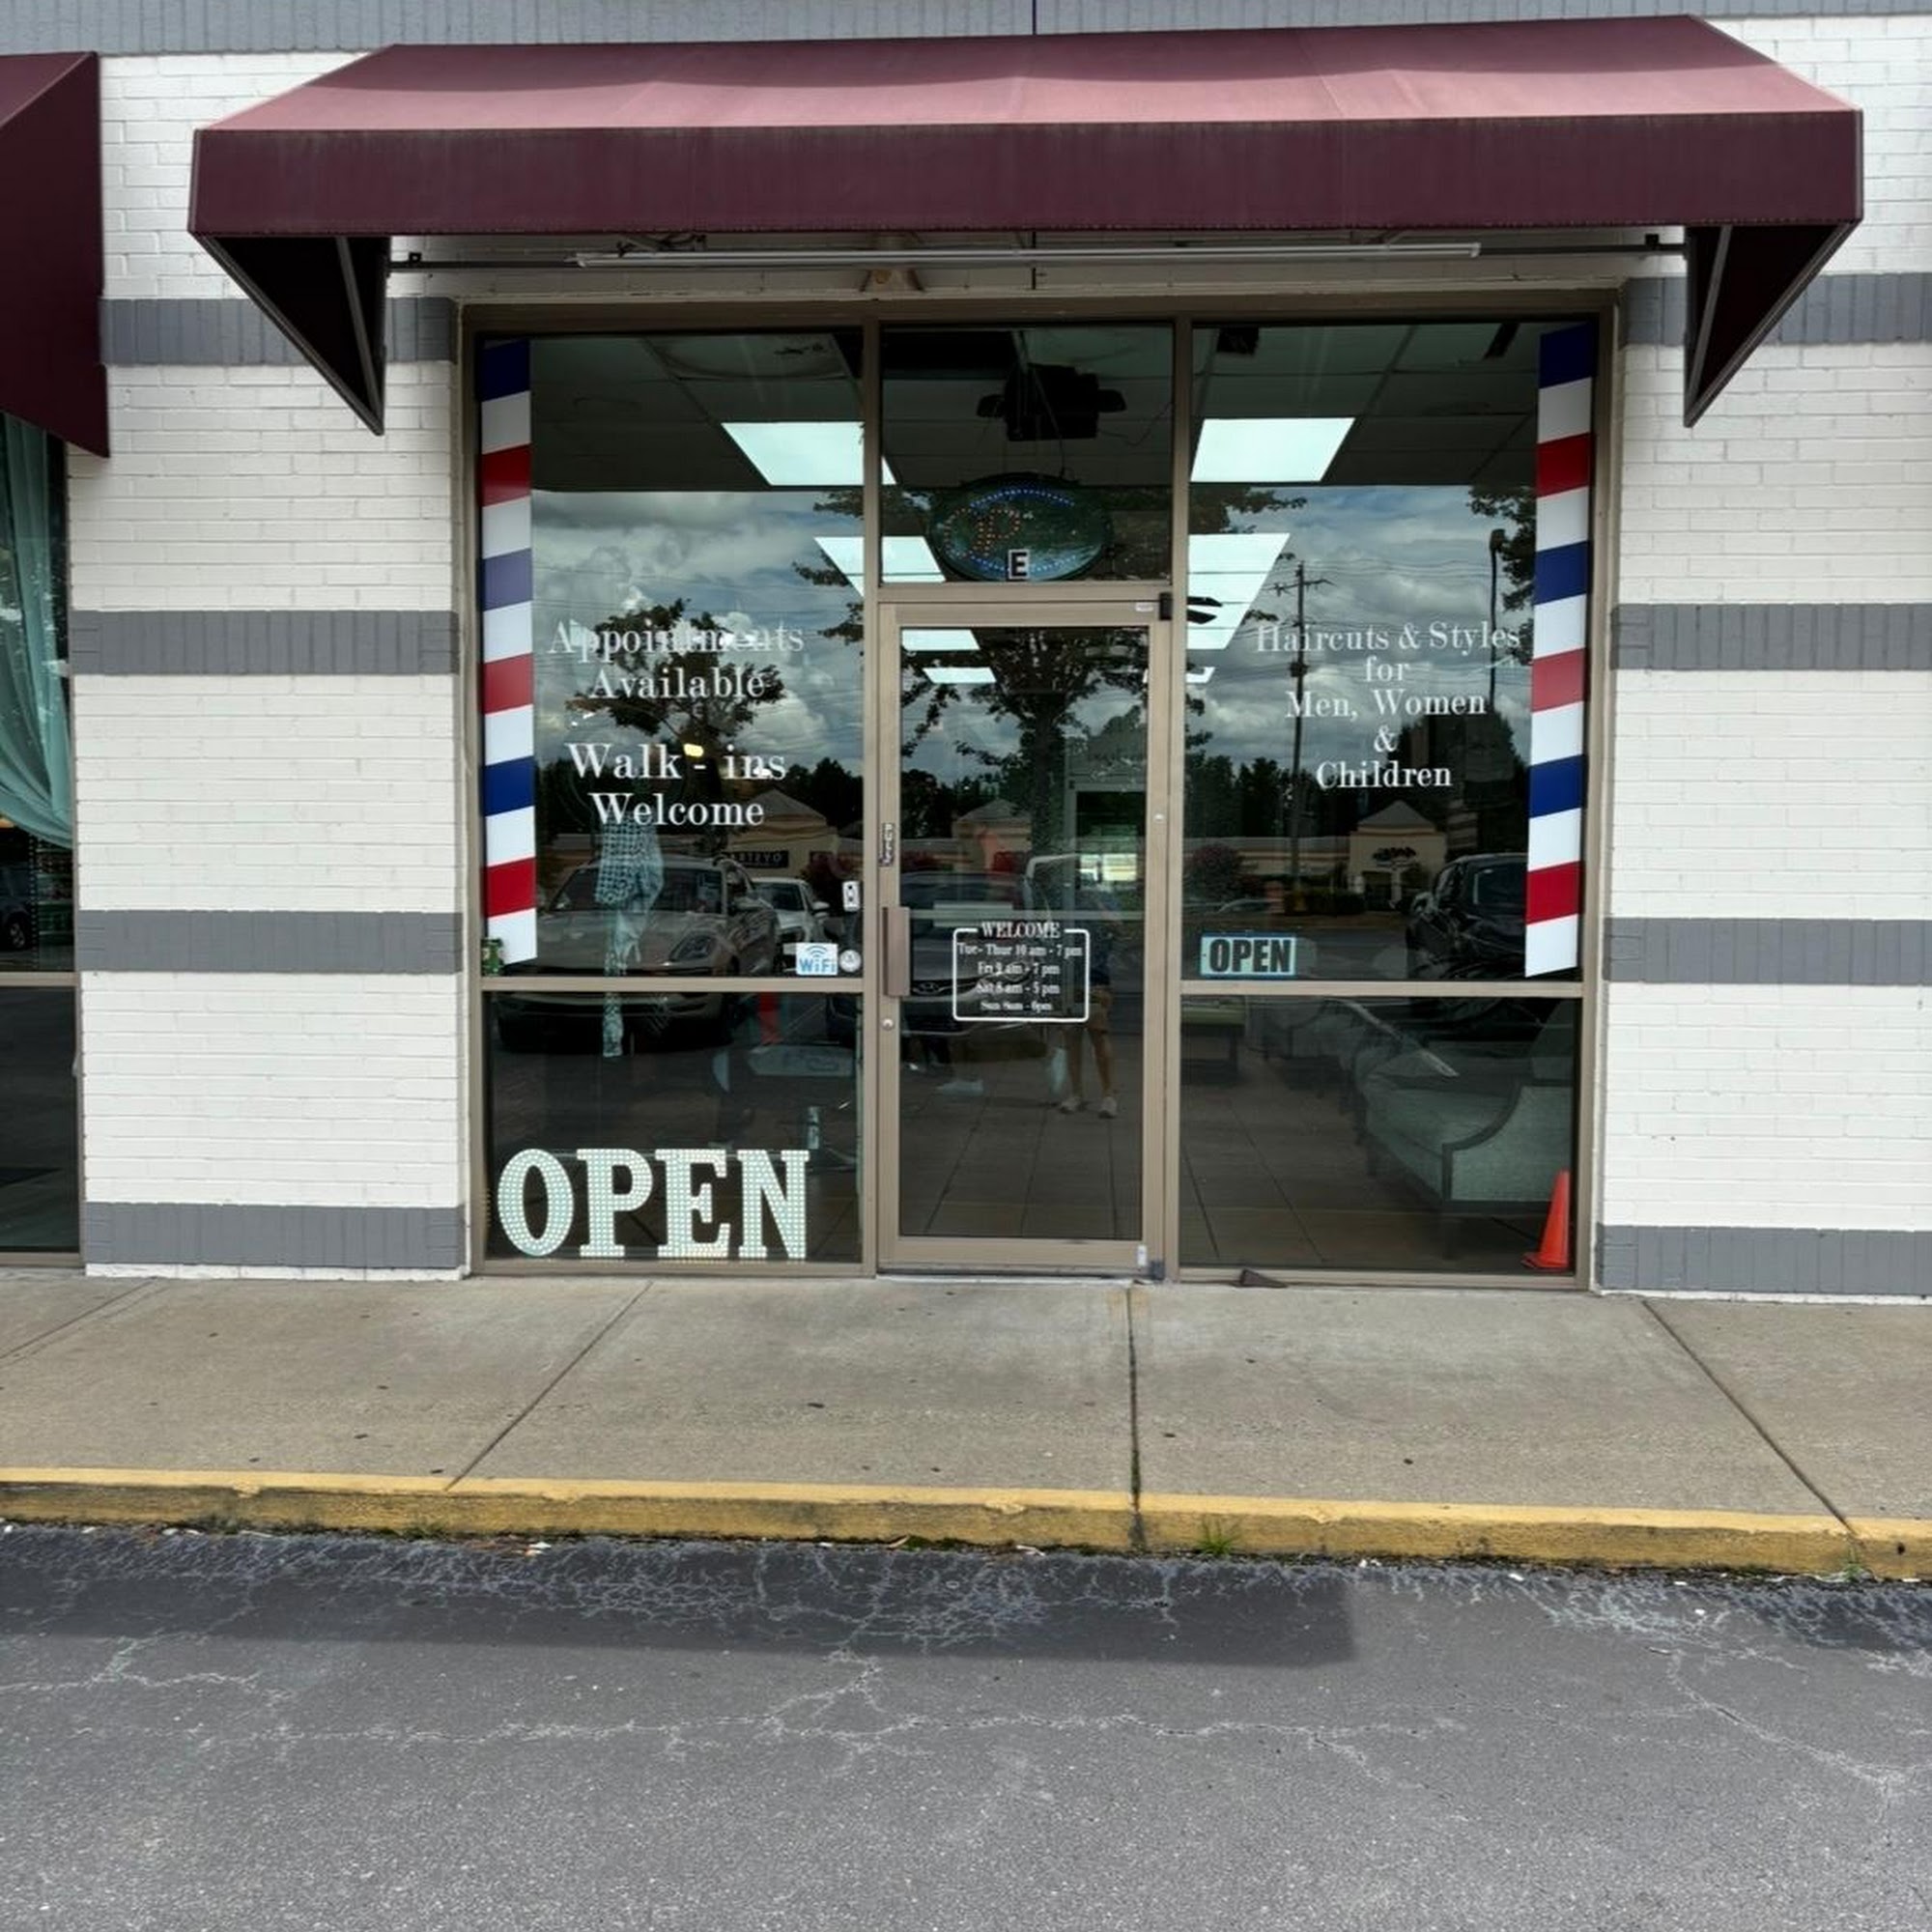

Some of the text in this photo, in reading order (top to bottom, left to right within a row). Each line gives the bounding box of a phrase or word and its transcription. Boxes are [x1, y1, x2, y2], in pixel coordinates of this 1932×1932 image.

[1012, 552, 1028, 577] E
[548, 620, 805, 664] Appointments
[1257, 621, 1520, 656] Haircuts & Styles
[588, 668, 765, 699] Available
[1365, 655, 1411, 682] for
[1285, 688, 1486, 723] Men, Women
[1373, 724, 1399, 753] &
[564, 742, 682, 780] Walk
[723, 743, 786, 781] ins
[1316, 760, 1453, 789] Children
[587, 792, 764, 826] Welcome
[981, 921, 1061, 938] WELCOME
[1209, 939, 1292, 972] OPEN
[497, 1149, 810, 1259] OPEN
